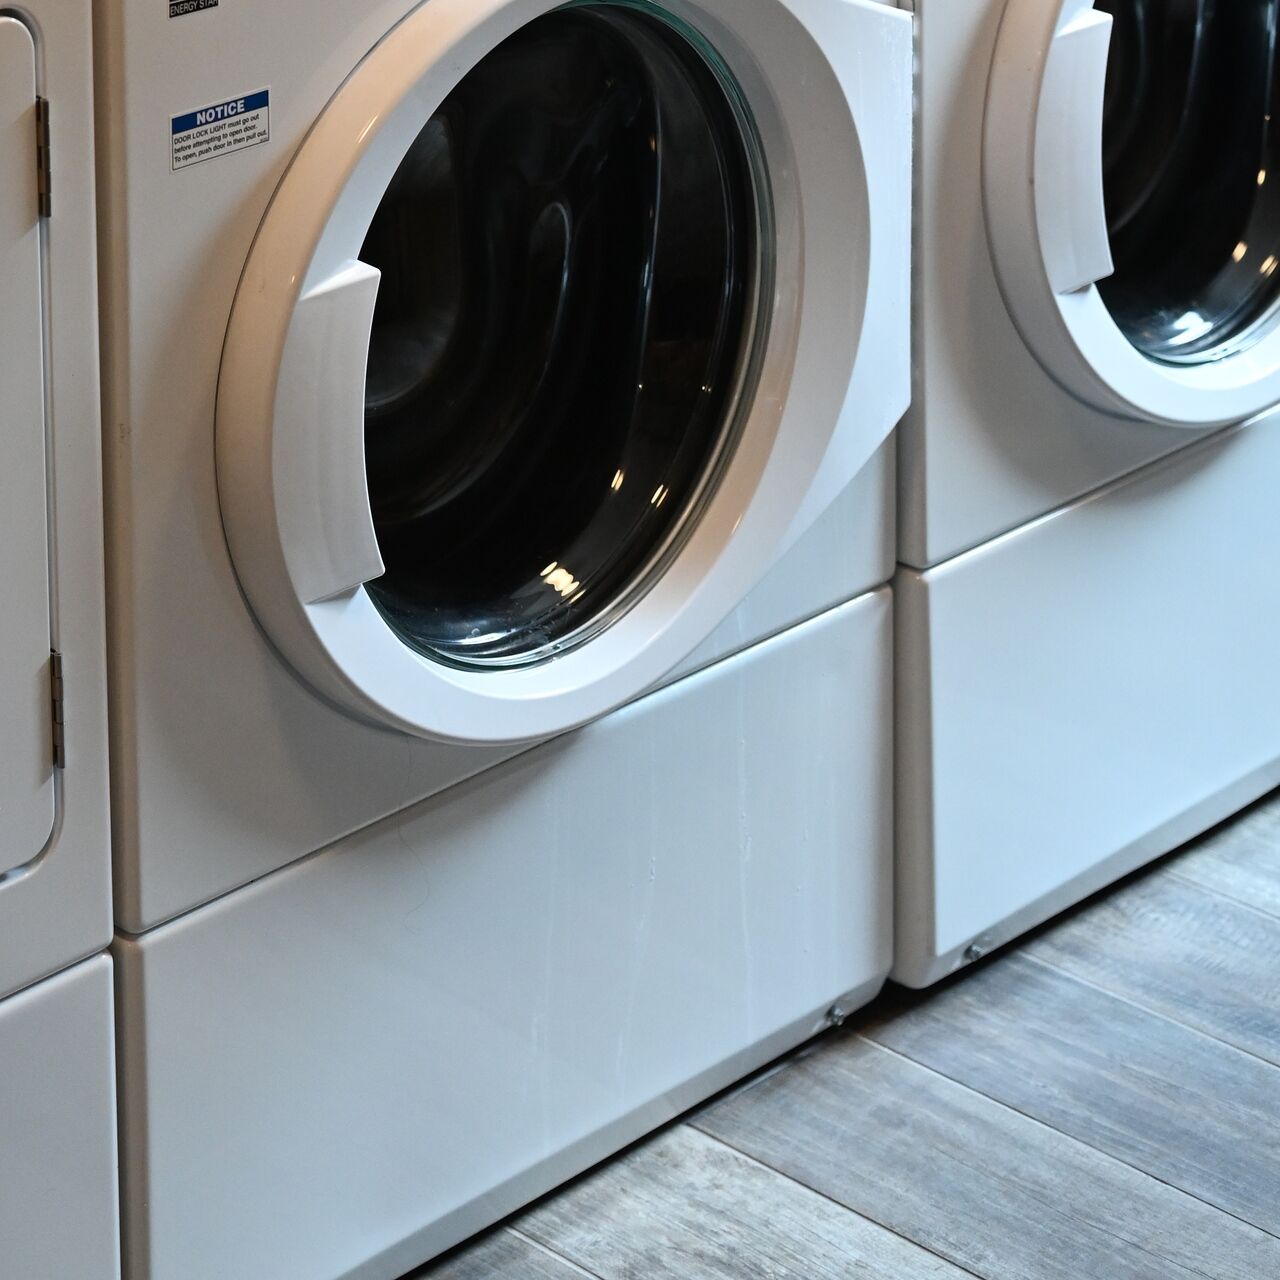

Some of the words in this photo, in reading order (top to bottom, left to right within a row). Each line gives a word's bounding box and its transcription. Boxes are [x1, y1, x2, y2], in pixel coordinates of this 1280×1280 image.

[170, 0, 198, 16] ENERGY
[196, 99, 245, 126] NOTICE
[173, 135, 192, 145] DOOR
[192, 129, 209, 140] LOCK
[209, 123, 227, 135] LIGHT
[227, 119, 242, 128] must
[242, 117, 249, 126] go
[250, 113, 260, 121] out
[174, 144, 192, 154] before
[192, 134, 221, 148] attempting
[229, 128, 243, 138] open
[198, 146, 213, 157] push
[213, 142, 226, 151] door
